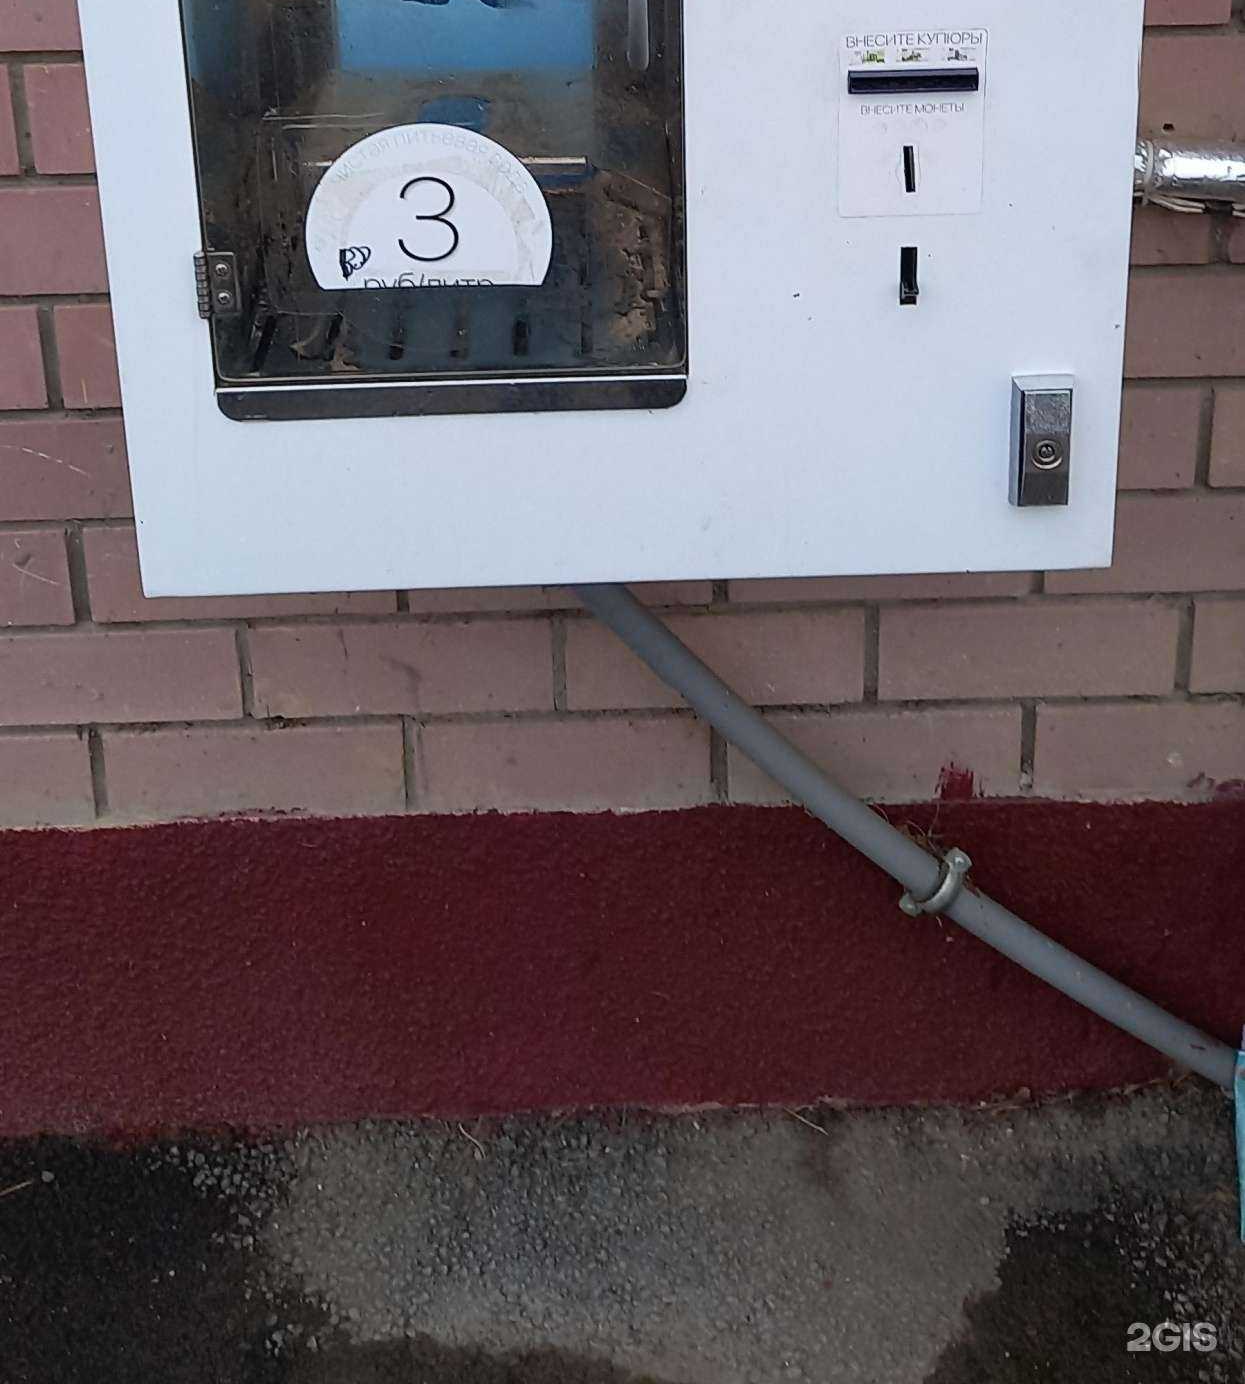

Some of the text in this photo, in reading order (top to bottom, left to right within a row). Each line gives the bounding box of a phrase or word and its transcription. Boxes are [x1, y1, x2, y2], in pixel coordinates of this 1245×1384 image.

[846, 31, 983, 49] ВНЕСИТЕ КУПЮРЫ
[860, 102, 965, 115] ВНЕСИТЕ МОНЕТЫ
[397, 175, 460, 262] 3
